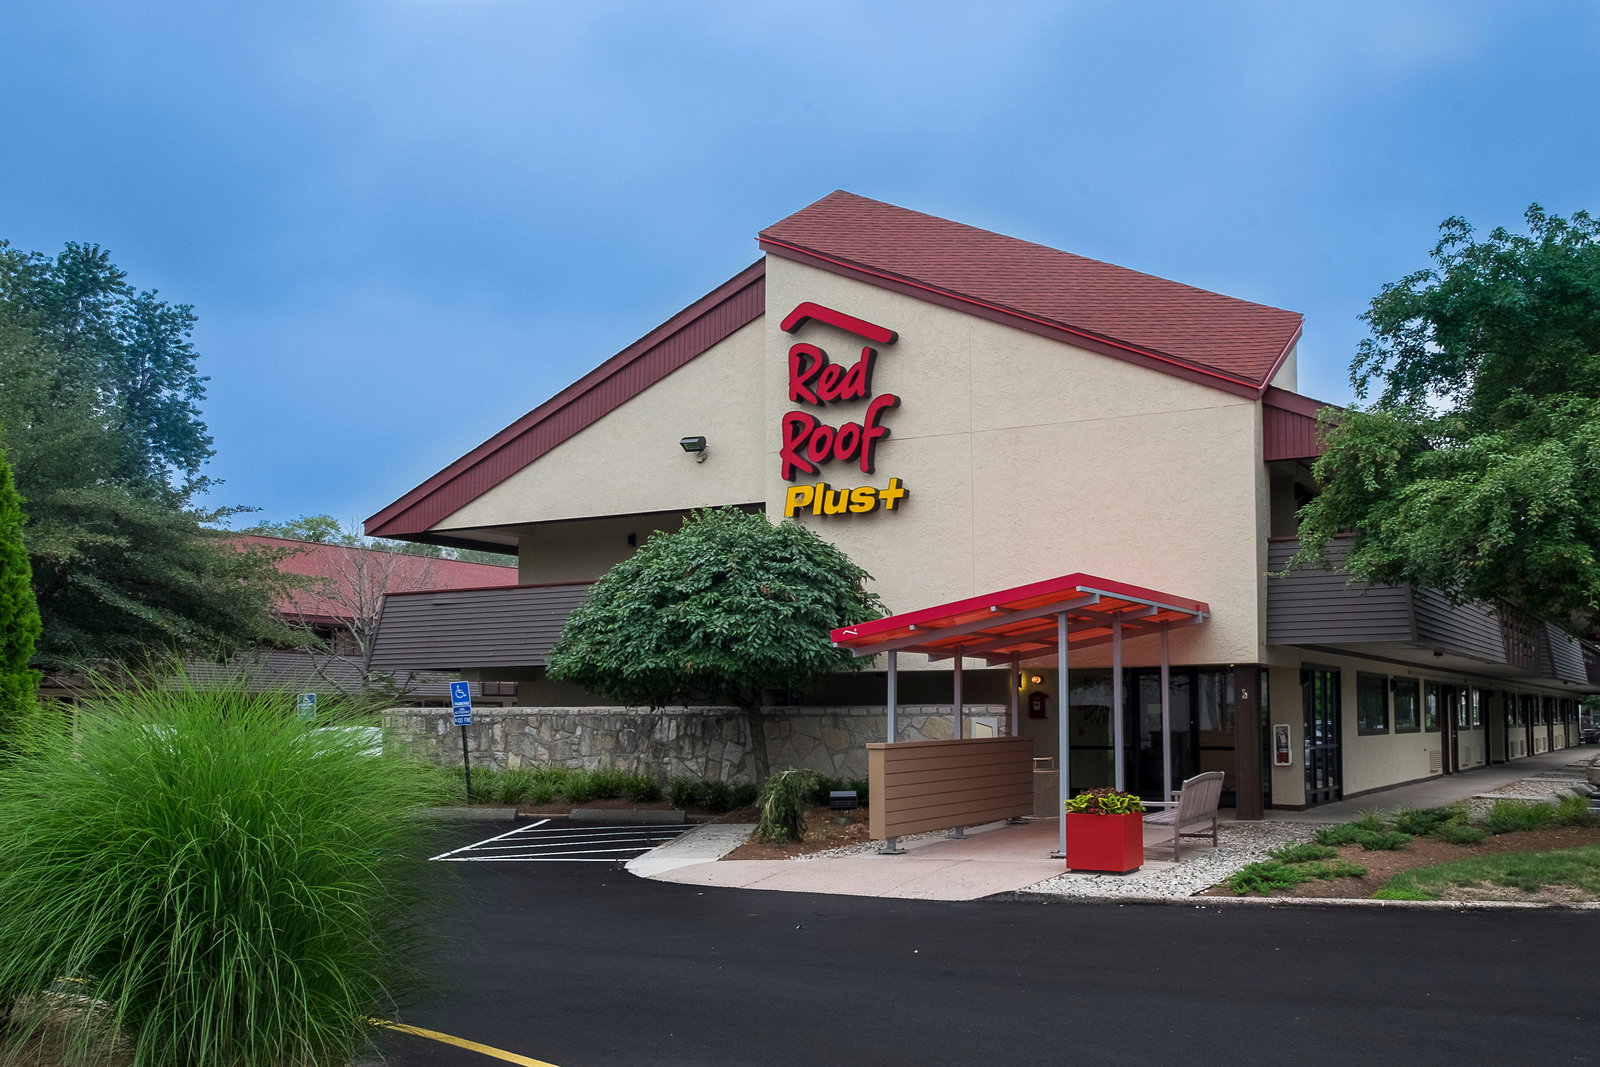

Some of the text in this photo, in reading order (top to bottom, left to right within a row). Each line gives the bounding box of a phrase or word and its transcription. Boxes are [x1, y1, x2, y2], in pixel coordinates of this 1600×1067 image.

[788, 343, 876, 406] Red
[780, 394, 900, 481] Roof
[784, 478, 908, 518] Plus+
